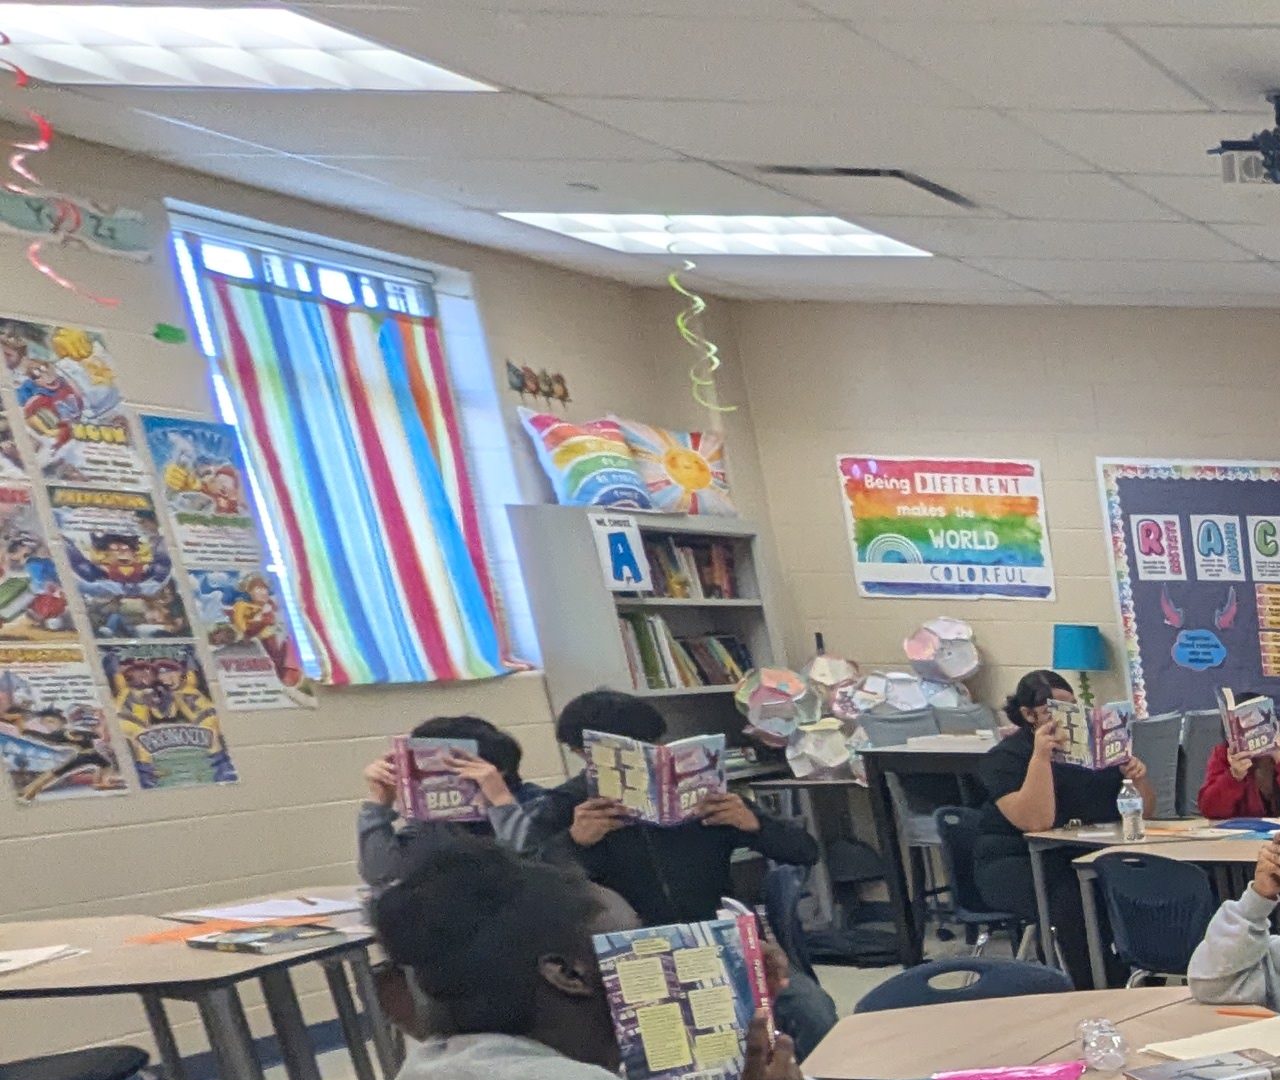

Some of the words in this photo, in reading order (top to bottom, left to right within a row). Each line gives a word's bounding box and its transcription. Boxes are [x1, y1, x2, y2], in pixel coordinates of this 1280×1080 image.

[864, 474, 910, 495] Being
[917, 474, 1021, 495] DIFFERENT
[897, 504, 946, 518] makes
[955, 507, 976, 519] the
[929, 529, 1000, 551] WORLD
[1137, 519, 1165, 557] R
[1197, 519, 1225, 557] A
[1254, 520, 1279, 558] C
[608, 531, 642, 584] A
[930, 566, 1027, 583] COLORFUL
[1105, 741, 1121, 758] BAD
[1248, 735, 1268, 750] BAD
[426, 790, 462, 809] BAD
